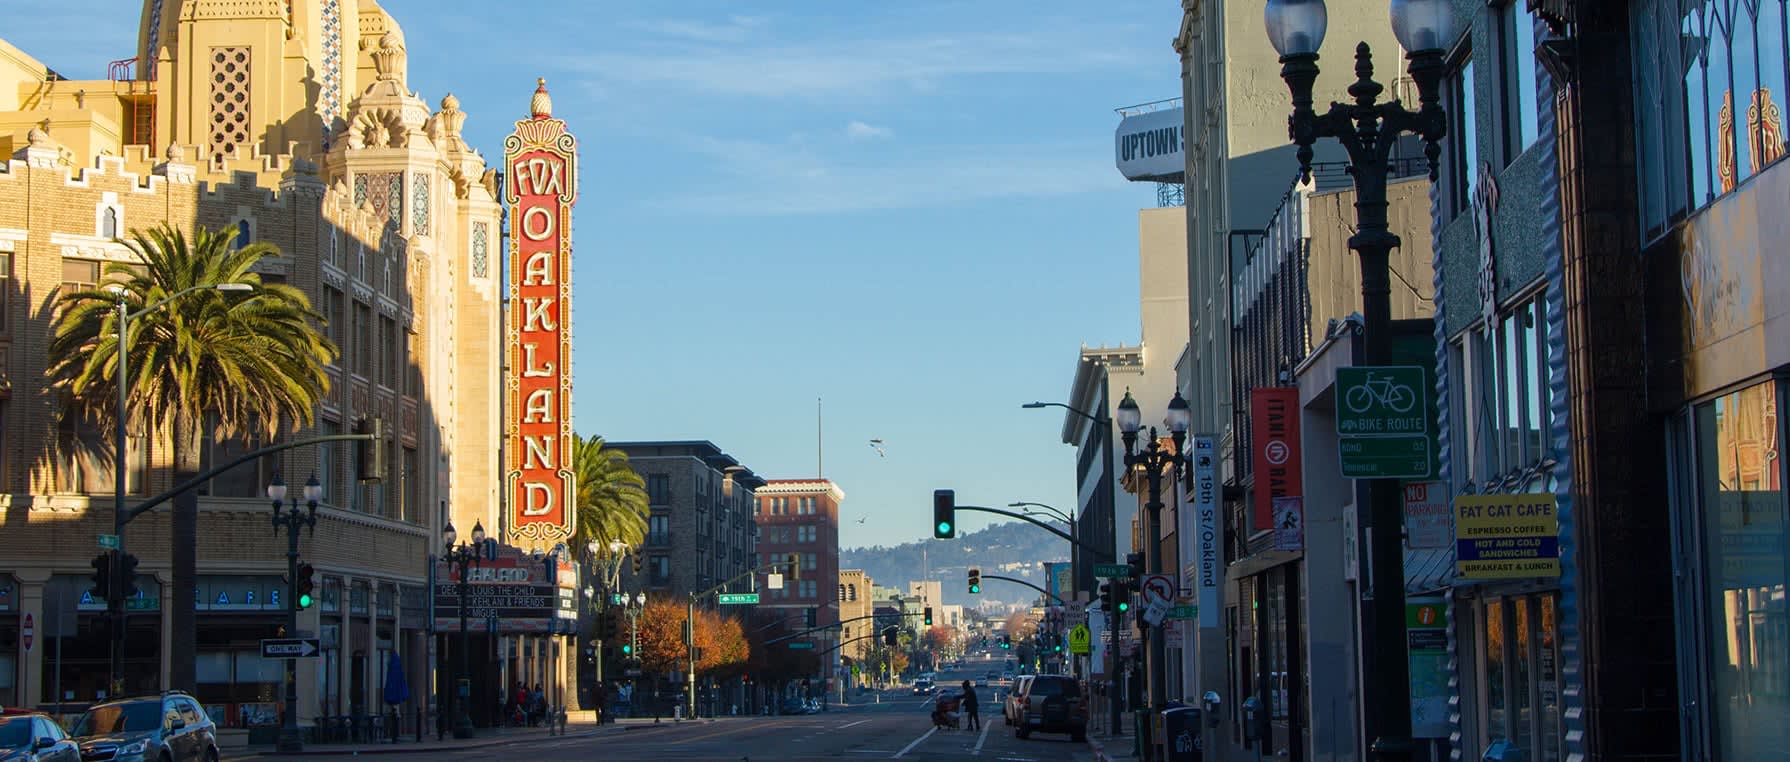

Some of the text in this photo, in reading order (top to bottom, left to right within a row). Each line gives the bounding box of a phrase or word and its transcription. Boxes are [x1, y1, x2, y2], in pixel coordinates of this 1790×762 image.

[1121, 126, 1178, 162] UPTOWN
[515, 160, 563, 196] FOX
[523, 206, 558, 517] OAKLAND
[1268, 399, 1285, 437] ITANI
[1359, 417, 1423, 431] BIKE ROUTE
[1200, 475, 1213, 505] 19th
[1407, 485, 1425, 501] NO
[1460, 503, 1552, 519] FAT CAT CAFE
[1467, 525, 1546, 535] ESPRESSO COFFEE
[1475, 539, 1542, 548] HOT AND COLD
[1479, 549, 1538, 557] SANDWICHES
[1465, 562, 1554, 572] BREAKFAST & LUNCH
[466, 567, 529, 582] AKLAND
[441, 586, 536, 596] DEC LOUIS THE CHILD
[472, 597, 505, 607] KEHLANI
[506, 597, 512, 606] &
[514, 597, 545, 607] FRIENDS
[472, 608, 500, 618] MIGUEL
[271, 645, 288, 653] ONE
